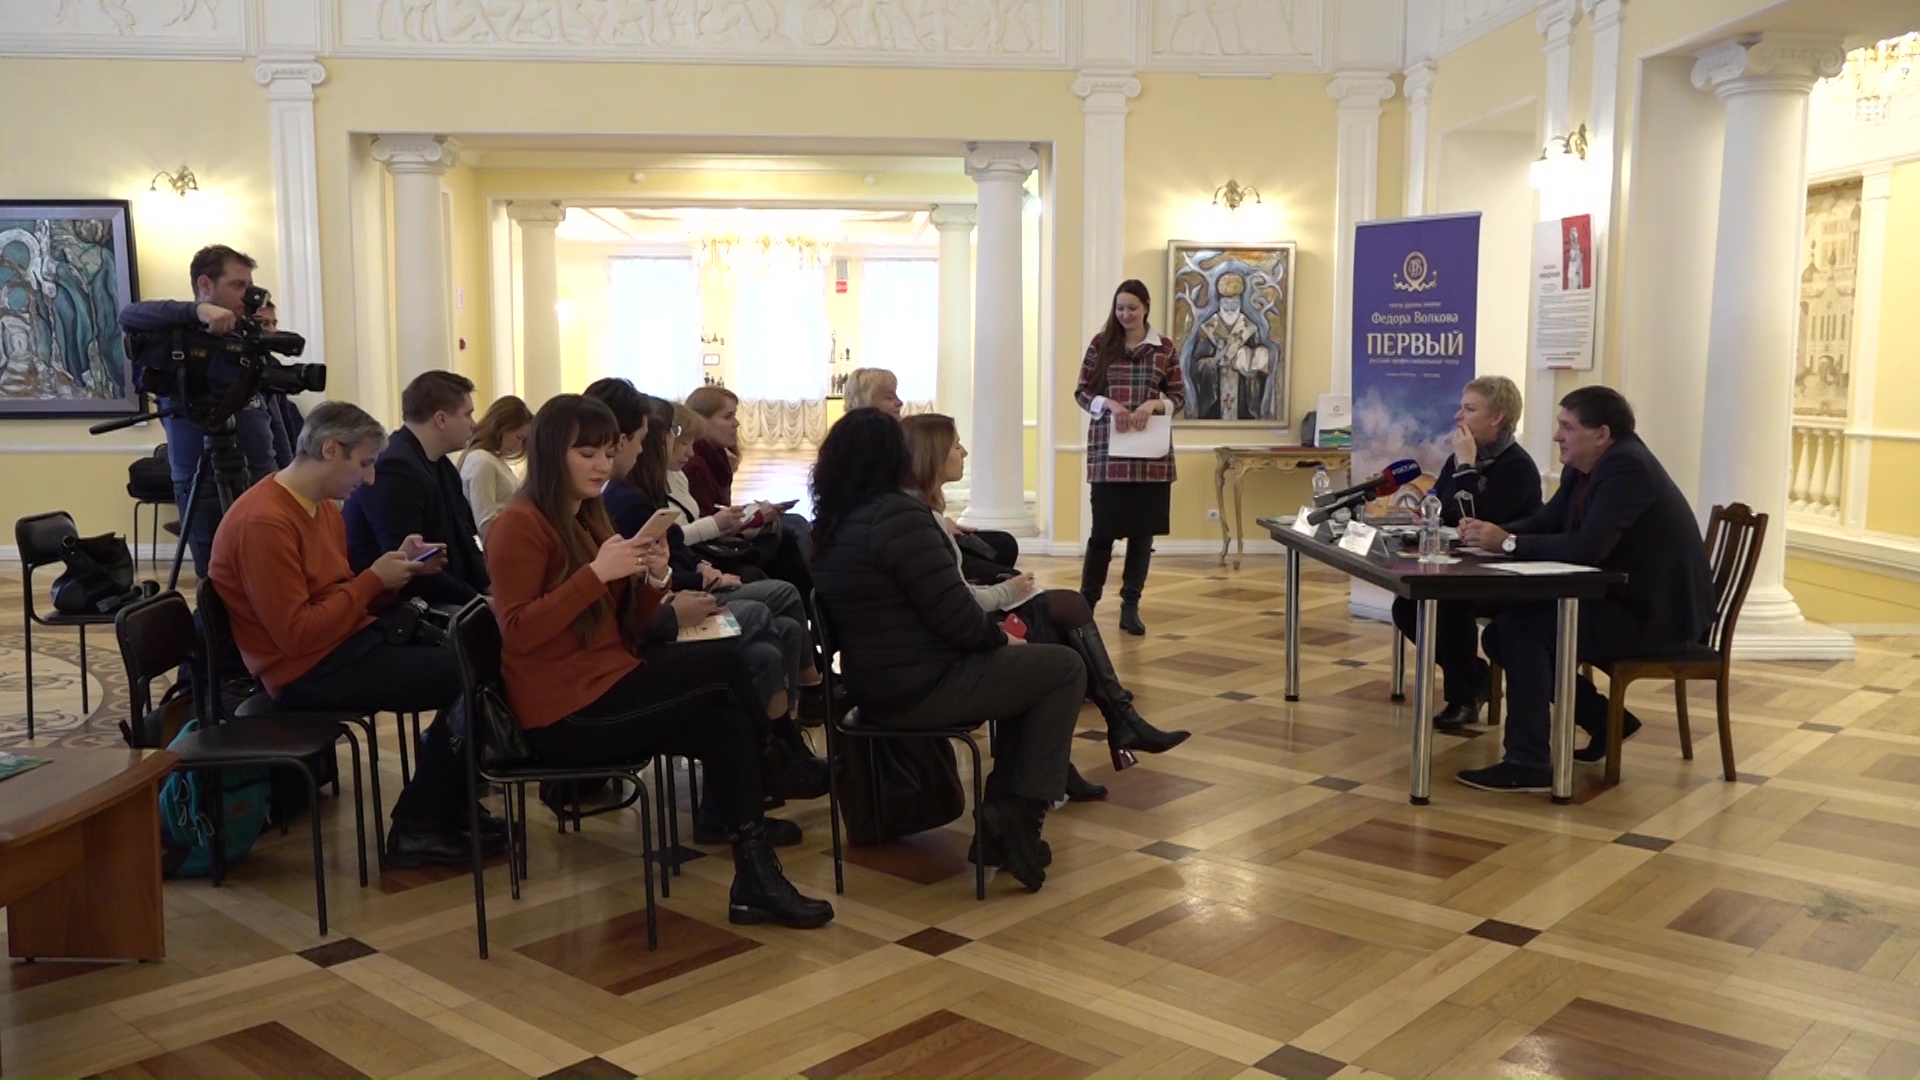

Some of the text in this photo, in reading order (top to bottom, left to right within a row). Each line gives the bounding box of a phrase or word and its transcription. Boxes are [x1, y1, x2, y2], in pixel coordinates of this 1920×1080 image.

[1371, 311, 1459, 325] Федора Волкова
[1366, 329, 1464, 356] ПЕРВЫЙ
